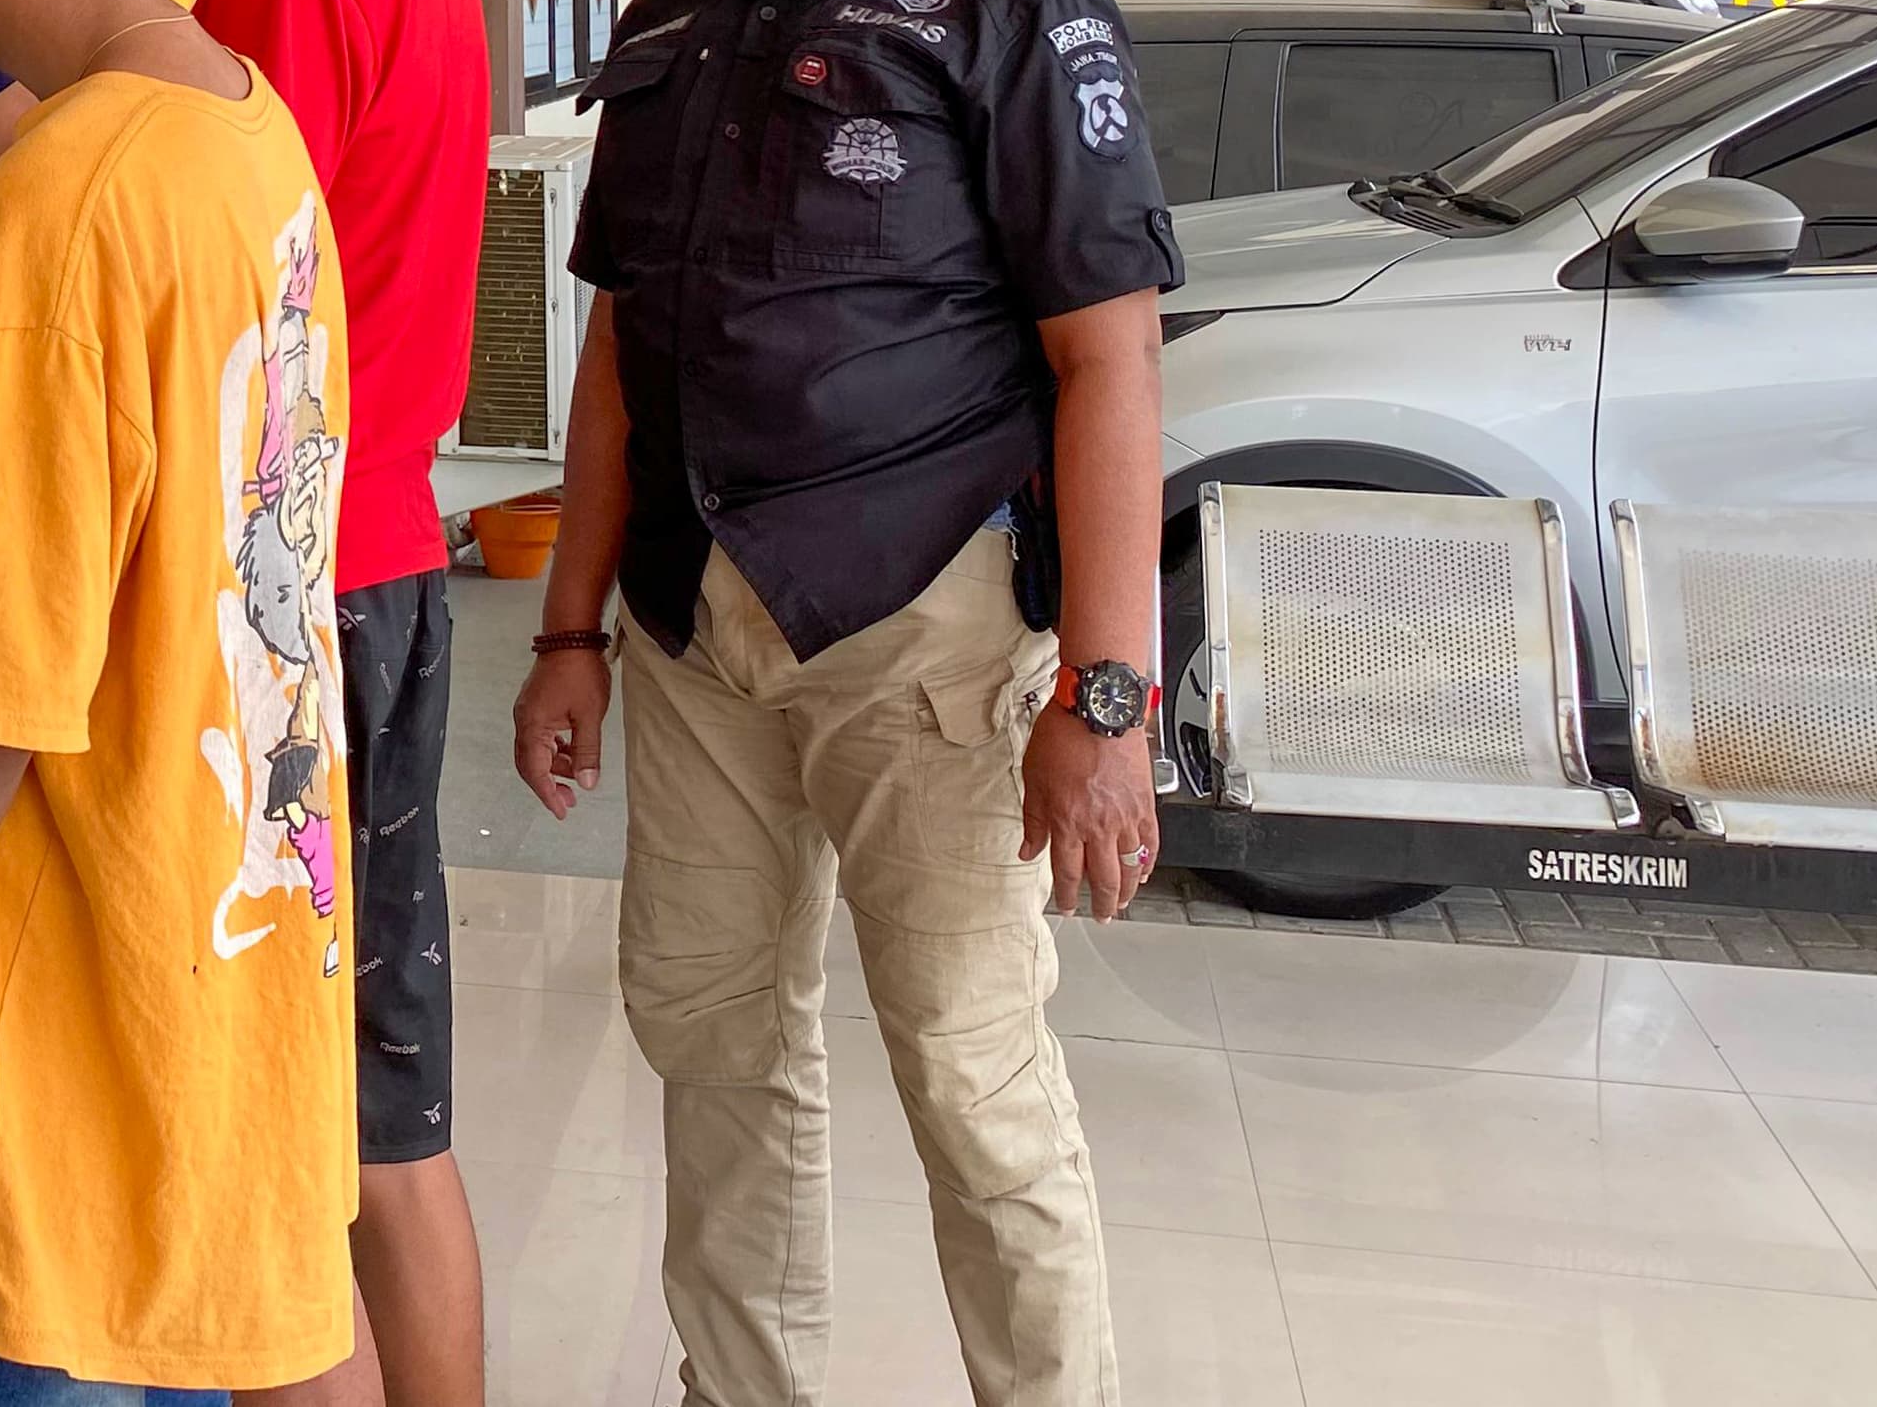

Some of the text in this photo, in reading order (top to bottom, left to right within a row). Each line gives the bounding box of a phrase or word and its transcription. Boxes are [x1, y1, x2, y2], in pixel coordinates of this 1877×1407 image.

[835, 4, 947, 43] HUMAS
[379, 806, 420, 837] Reebok
[1528, 849, 1688, 888] SATRESKRIM
[380, 1041, 421, 1055] Reebok
